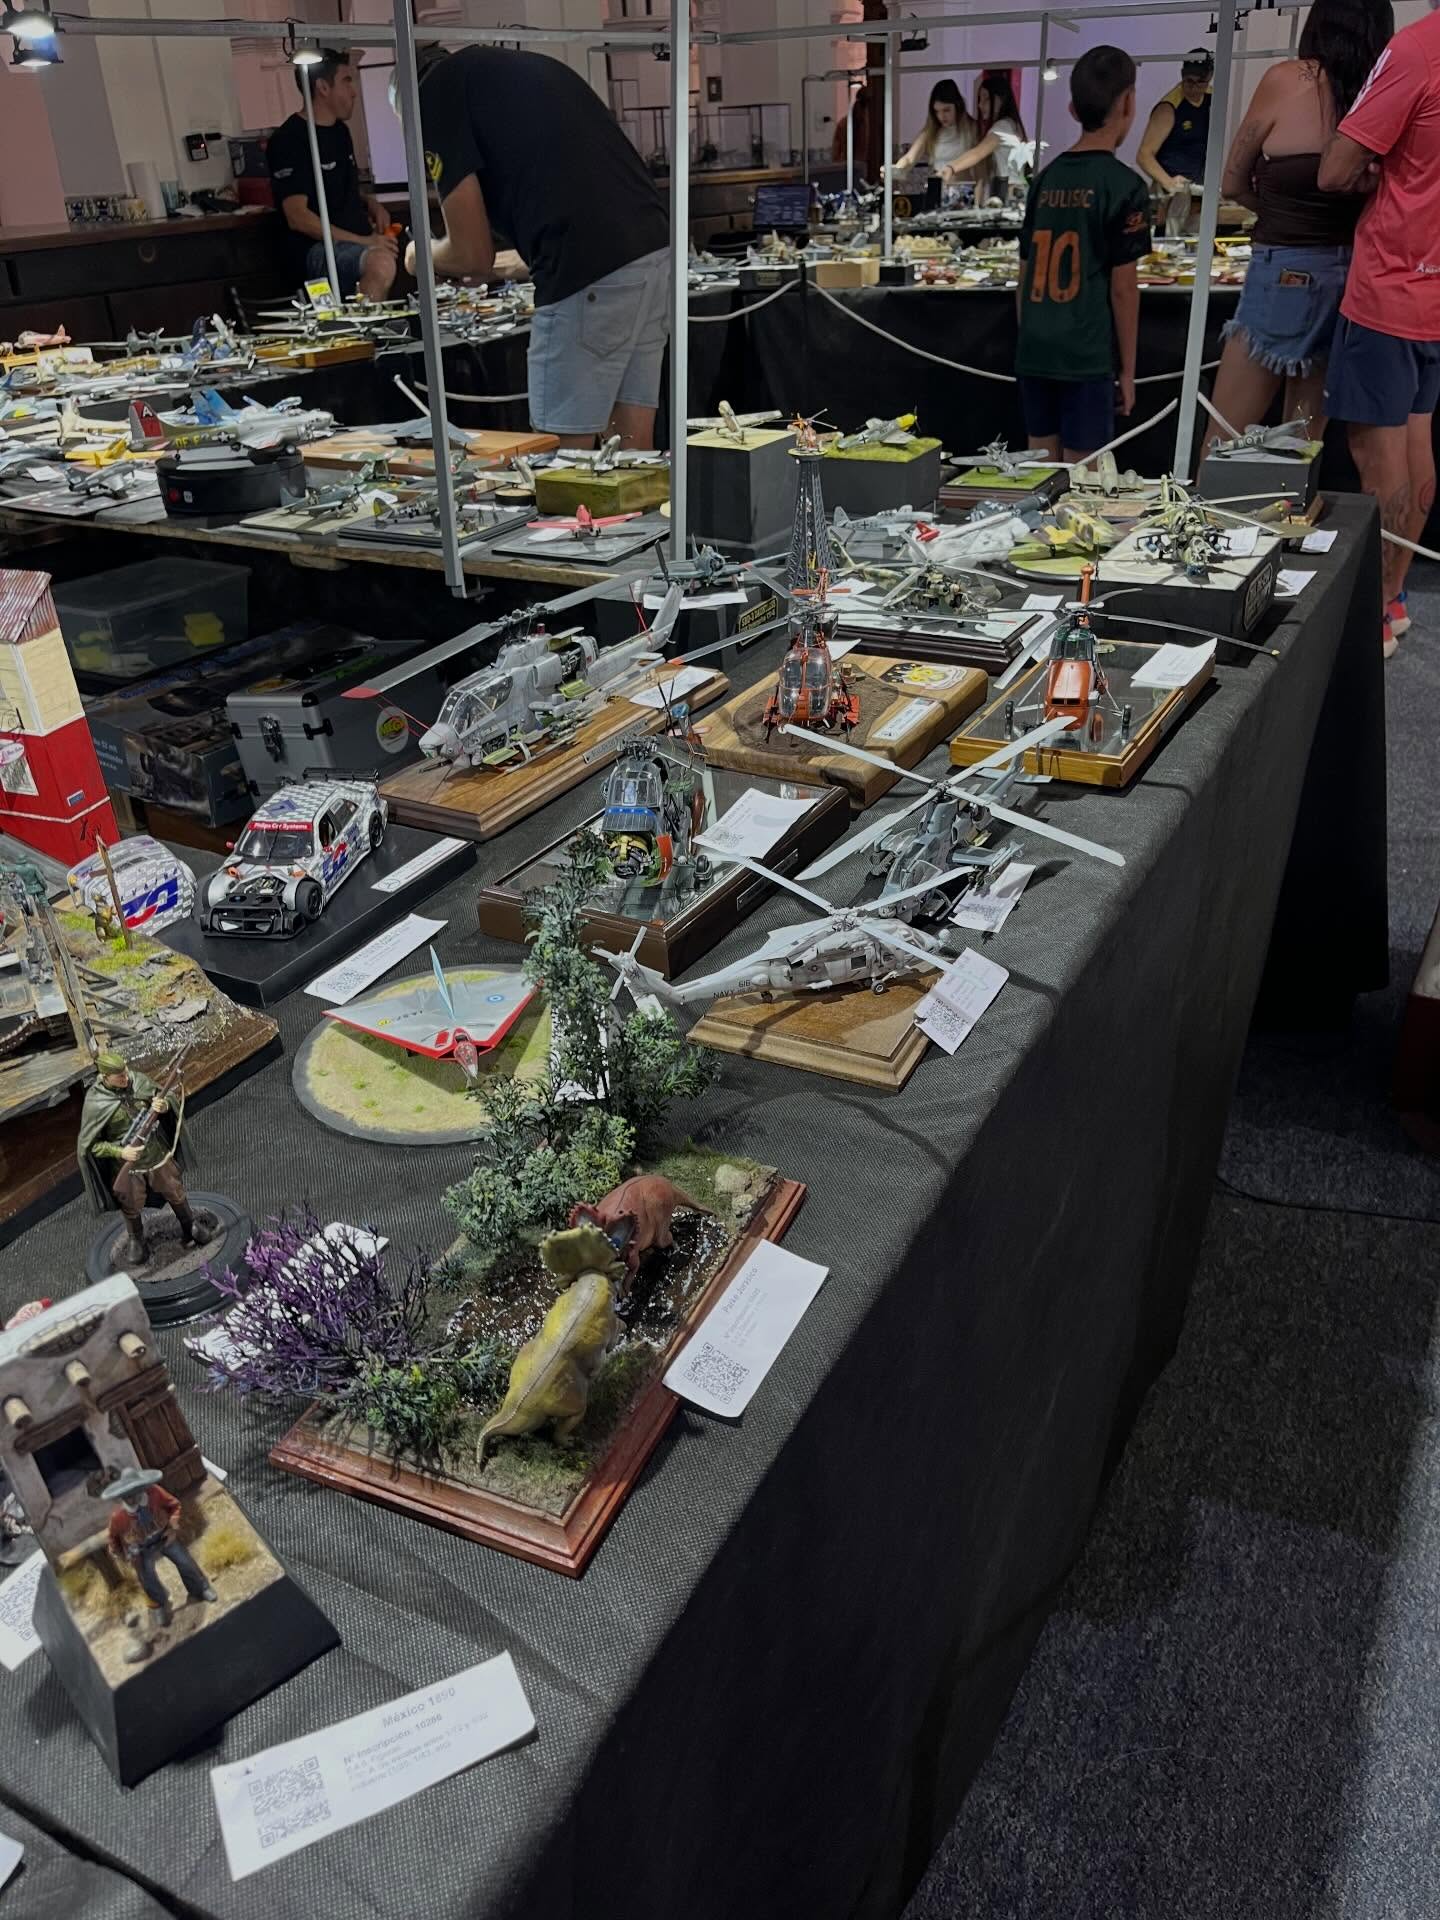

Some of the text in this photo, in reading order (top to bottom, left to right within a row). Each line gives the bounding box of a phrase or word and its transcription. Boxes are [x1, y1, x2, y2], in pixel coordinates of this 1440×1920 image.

[1037, 188, 1094, 208] PULISIC
[1030, 229, 1081, 303] 10
[282, 823, 308, 831] Systems
[382, 1703, 425, 1728] México
